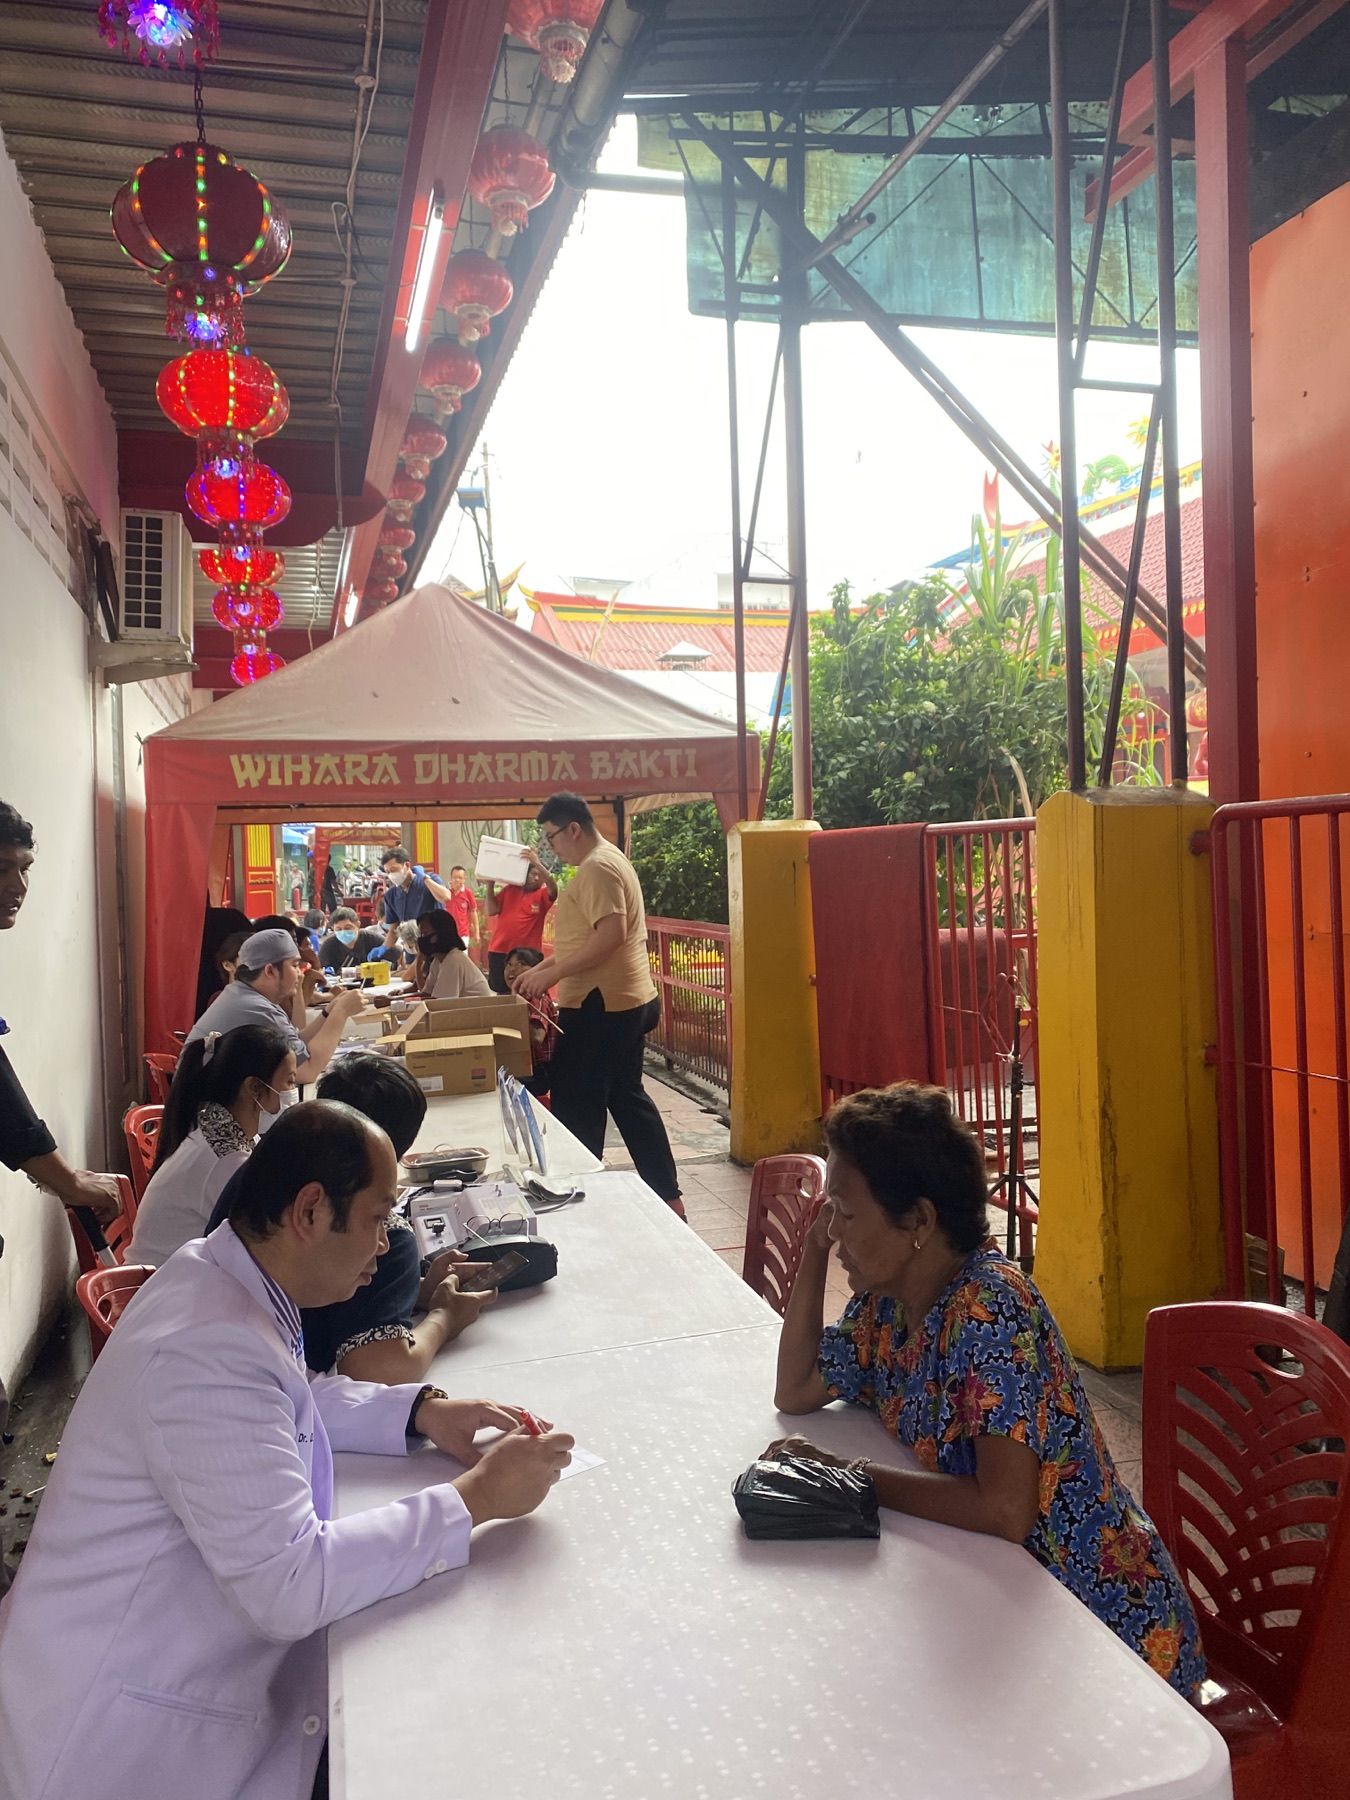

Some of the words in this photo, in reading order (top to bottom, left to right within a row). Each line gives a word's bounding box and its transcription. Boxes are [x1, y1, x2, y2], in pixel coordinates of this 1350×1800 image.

[229, 752, 400, 788] WIHARA
[413, 750, 578, 784] DHARMA
[590, 748, 697, 780] BAKTI
[298, 1432, 308, 1443] Dr.
